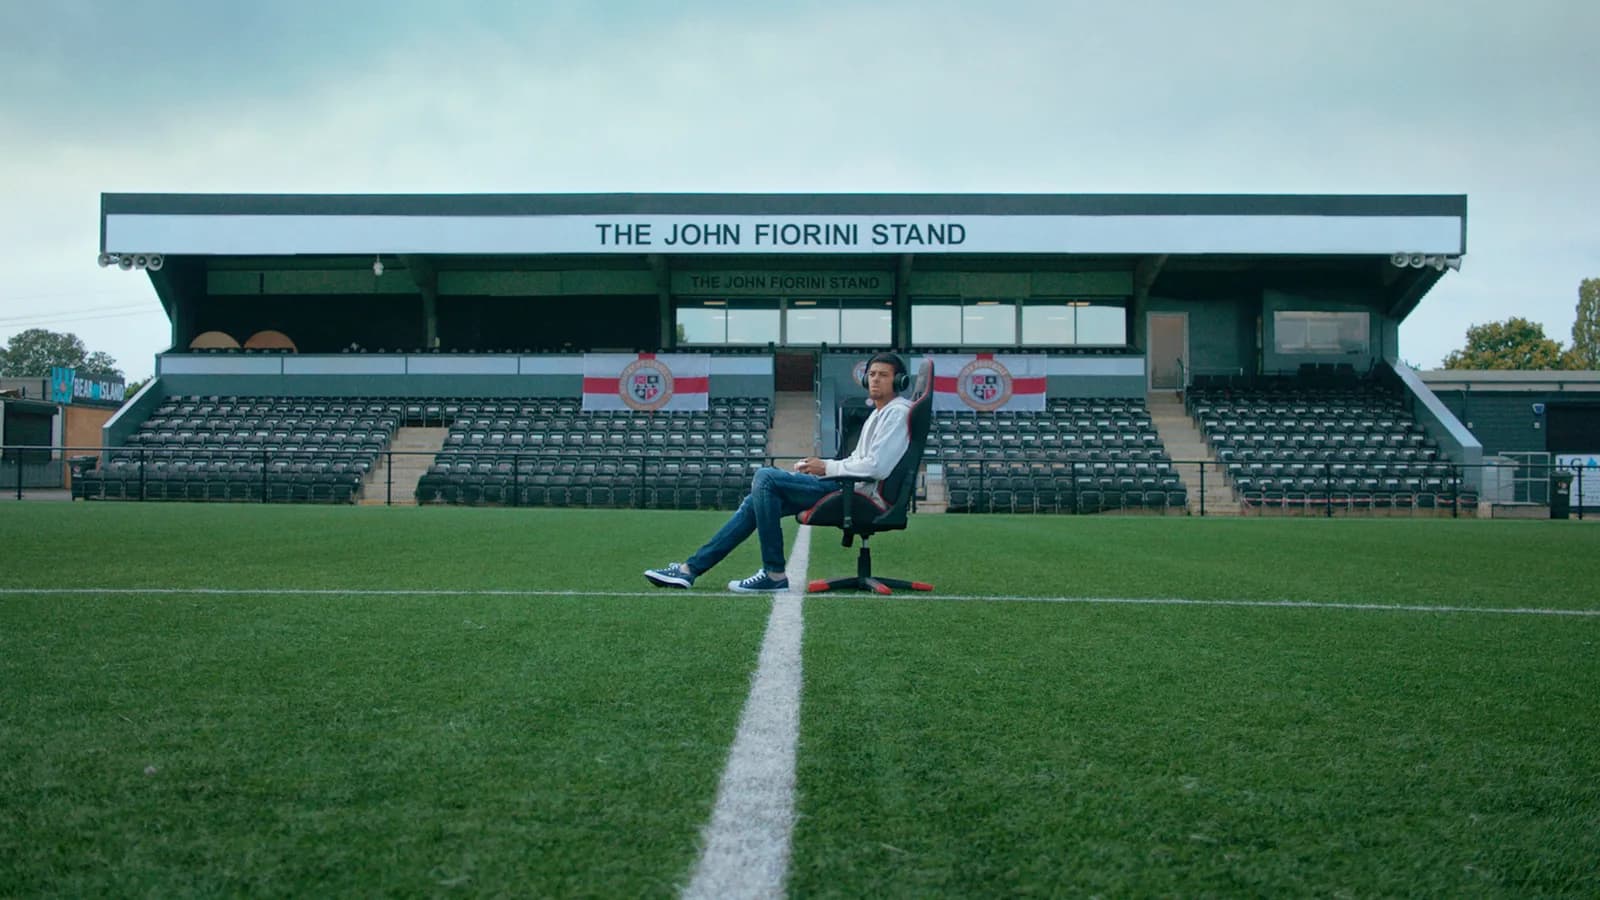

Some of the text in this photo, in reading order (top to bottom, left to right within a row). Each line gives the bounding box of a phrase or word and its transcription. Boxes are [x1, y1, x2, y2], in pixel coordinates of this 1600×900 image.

[596, 224, 966, 245] THE JOHN FIORINI STAND
[691, 276, 880, 289] THE JOHN FIORINI STAND
[74, 378, 124, 400] BEAR ISLAND
